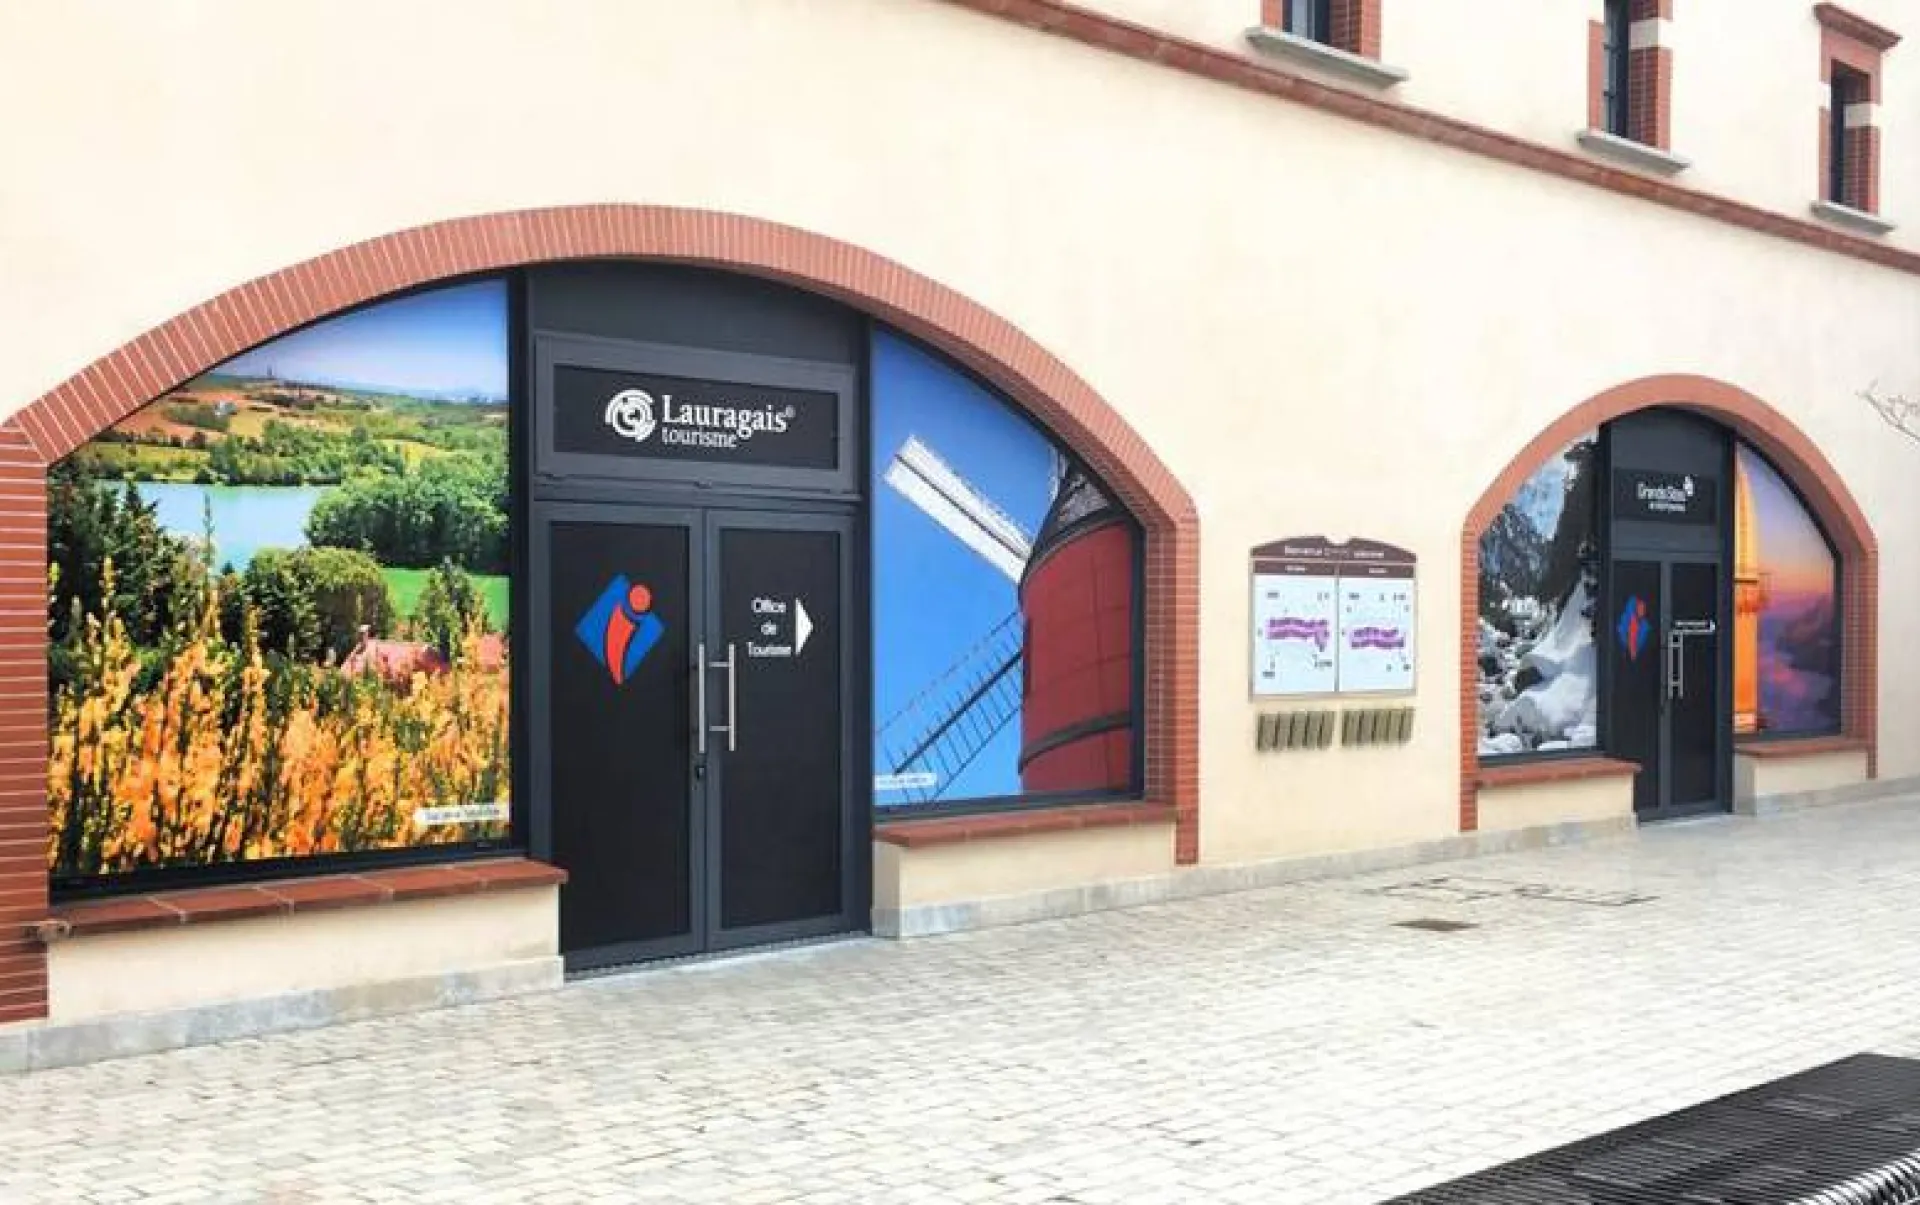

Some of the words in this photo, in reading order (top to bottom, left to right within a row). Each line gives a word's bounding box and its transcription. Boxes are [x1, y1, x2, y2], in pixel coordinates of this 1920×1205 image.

[661, 426, 738, 448] tourisme
[751, 597, 787, 613] Office
[761, 620, 777, 636] de
